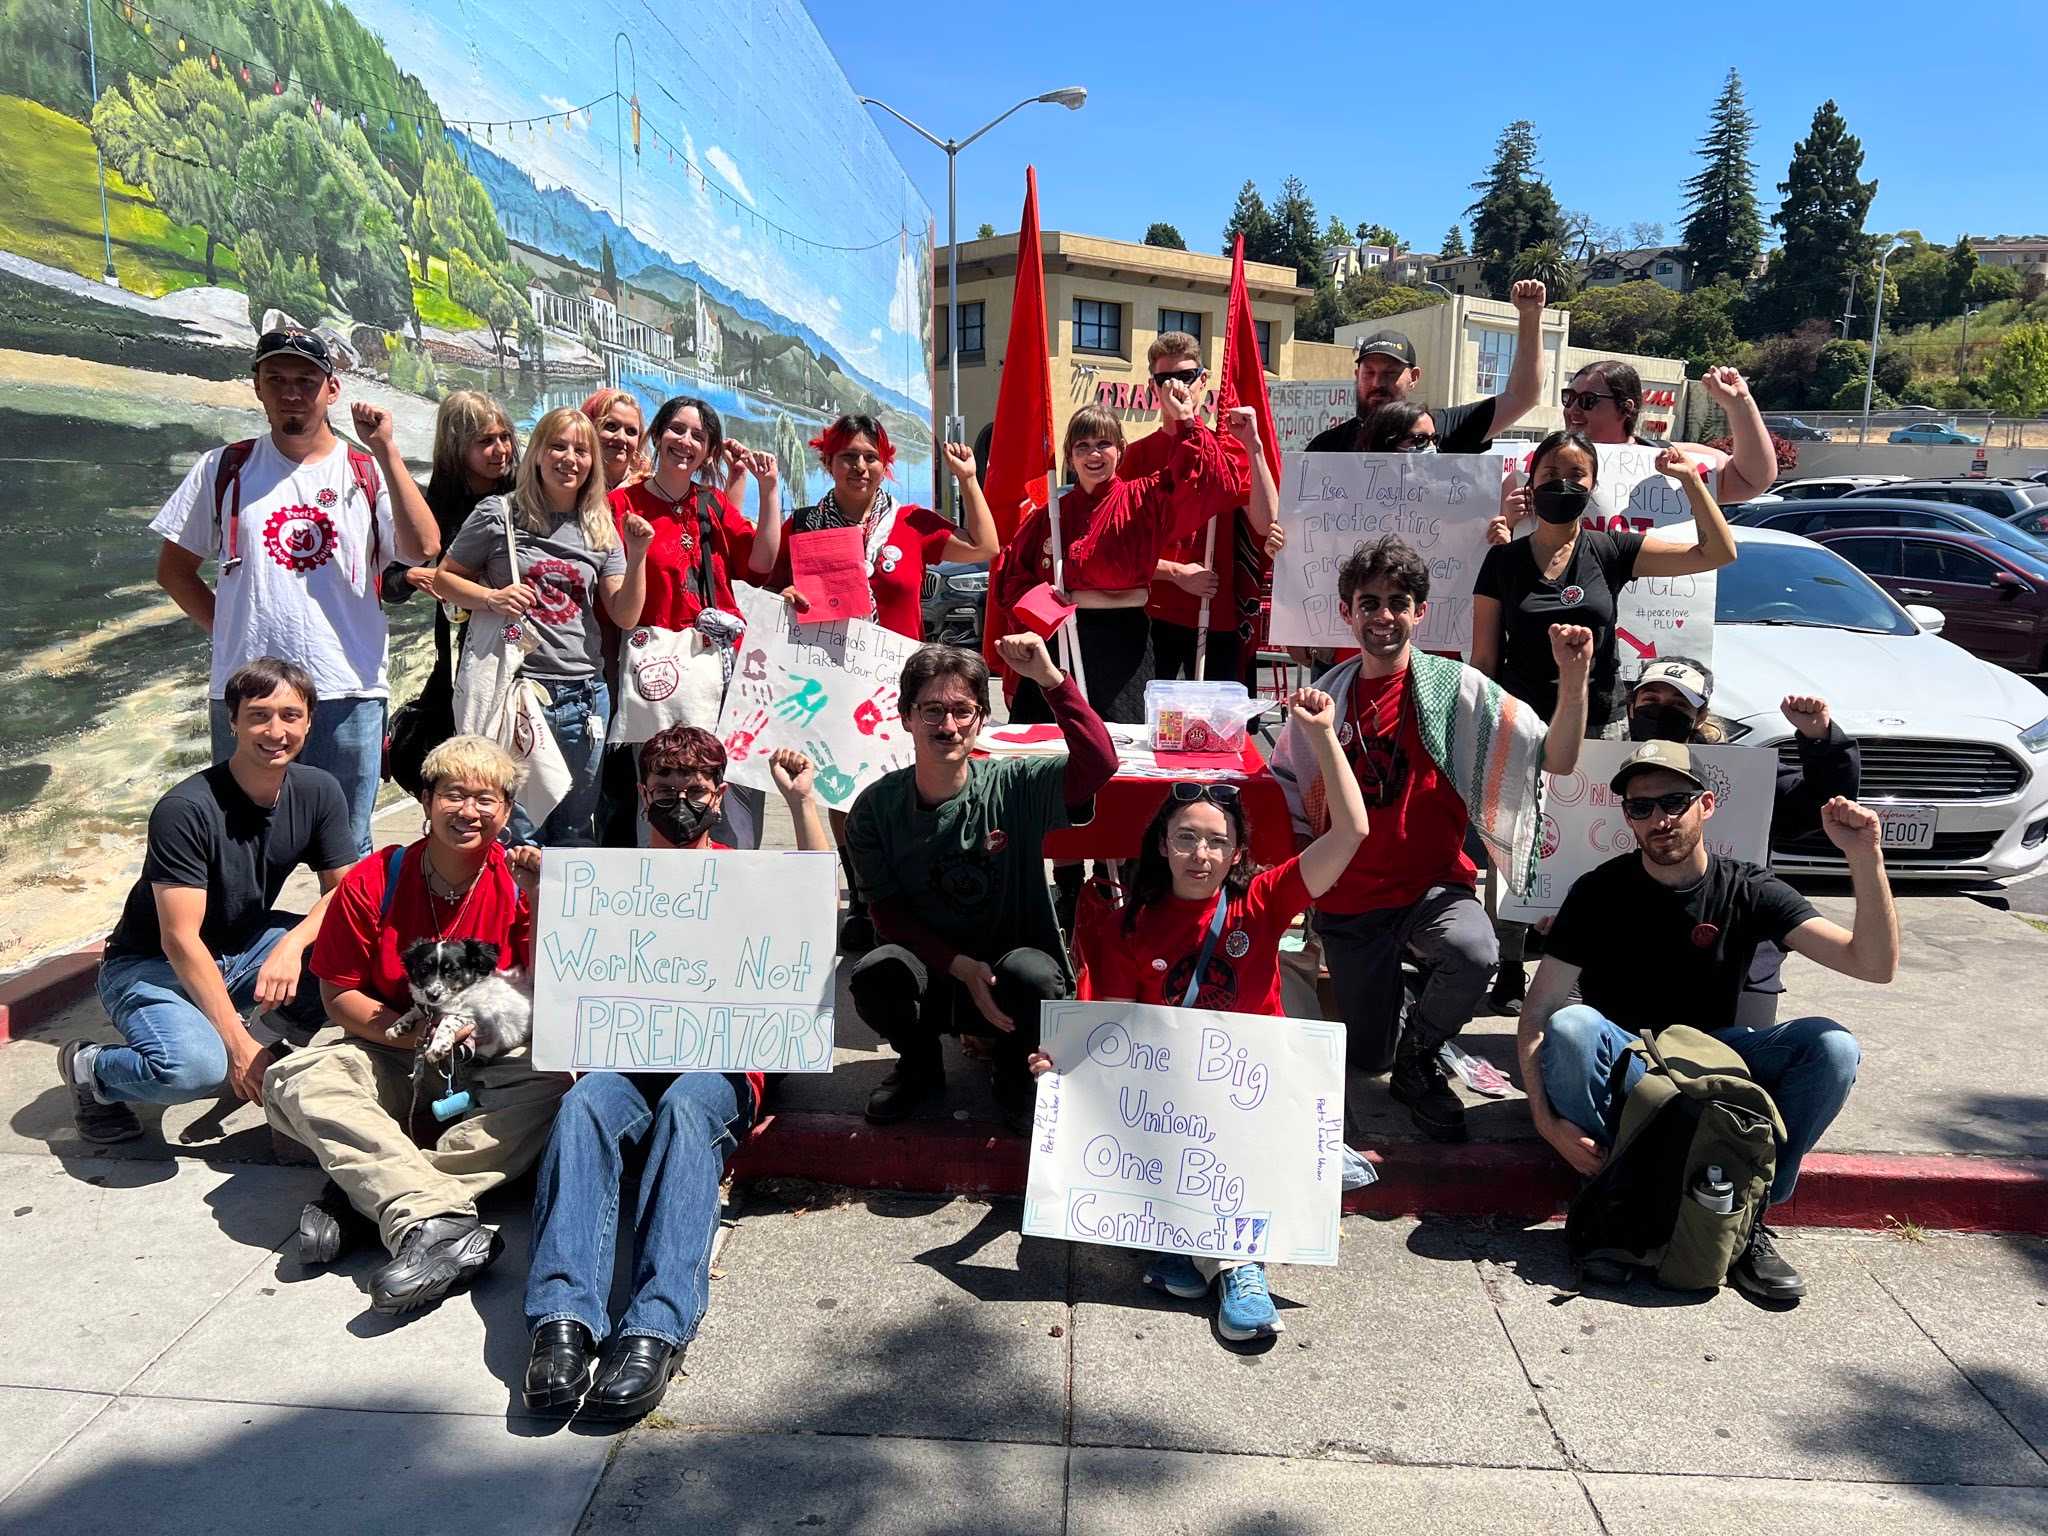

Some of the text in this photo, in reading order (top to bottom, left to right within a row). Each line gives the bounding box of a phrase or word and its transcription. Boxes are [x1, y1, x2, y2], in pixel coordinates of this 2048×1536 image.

[1298, 459, 1465, 507] Lisa Taylor is
[1614, 482, 1683, 515] PRICES
[284, 509, 316, 521] Peet's
[1303, 503, 1441, 552] protecting
[1582, 515, 1655, 534] NOT
[268, 537, 334, 564] Labor Union
[770, 596, 905, 665] The Hands That
[1653, 619, 1674, 630] PLU
[795, 640, 839, 667] Make
[843, 654, 873, 679] Your
[1663, 665, 1688, 679] Cal
[561, 858, 719, 920] Protect
[735, 936, 812, 992] Not
[576, 1000, 834, 1070] PREDATORS
[1086, 1022, 1268, 1111] One Big
[1034, 1097, 1048, 1129] PLU
[1119, 1086, 1216, 1143] Union,
[1325, 1118, 1342, 1152] PLU
[1083, 1134, 1244, 1217] One Big
[1071, 1193, 1268, 1254] Contract!!
